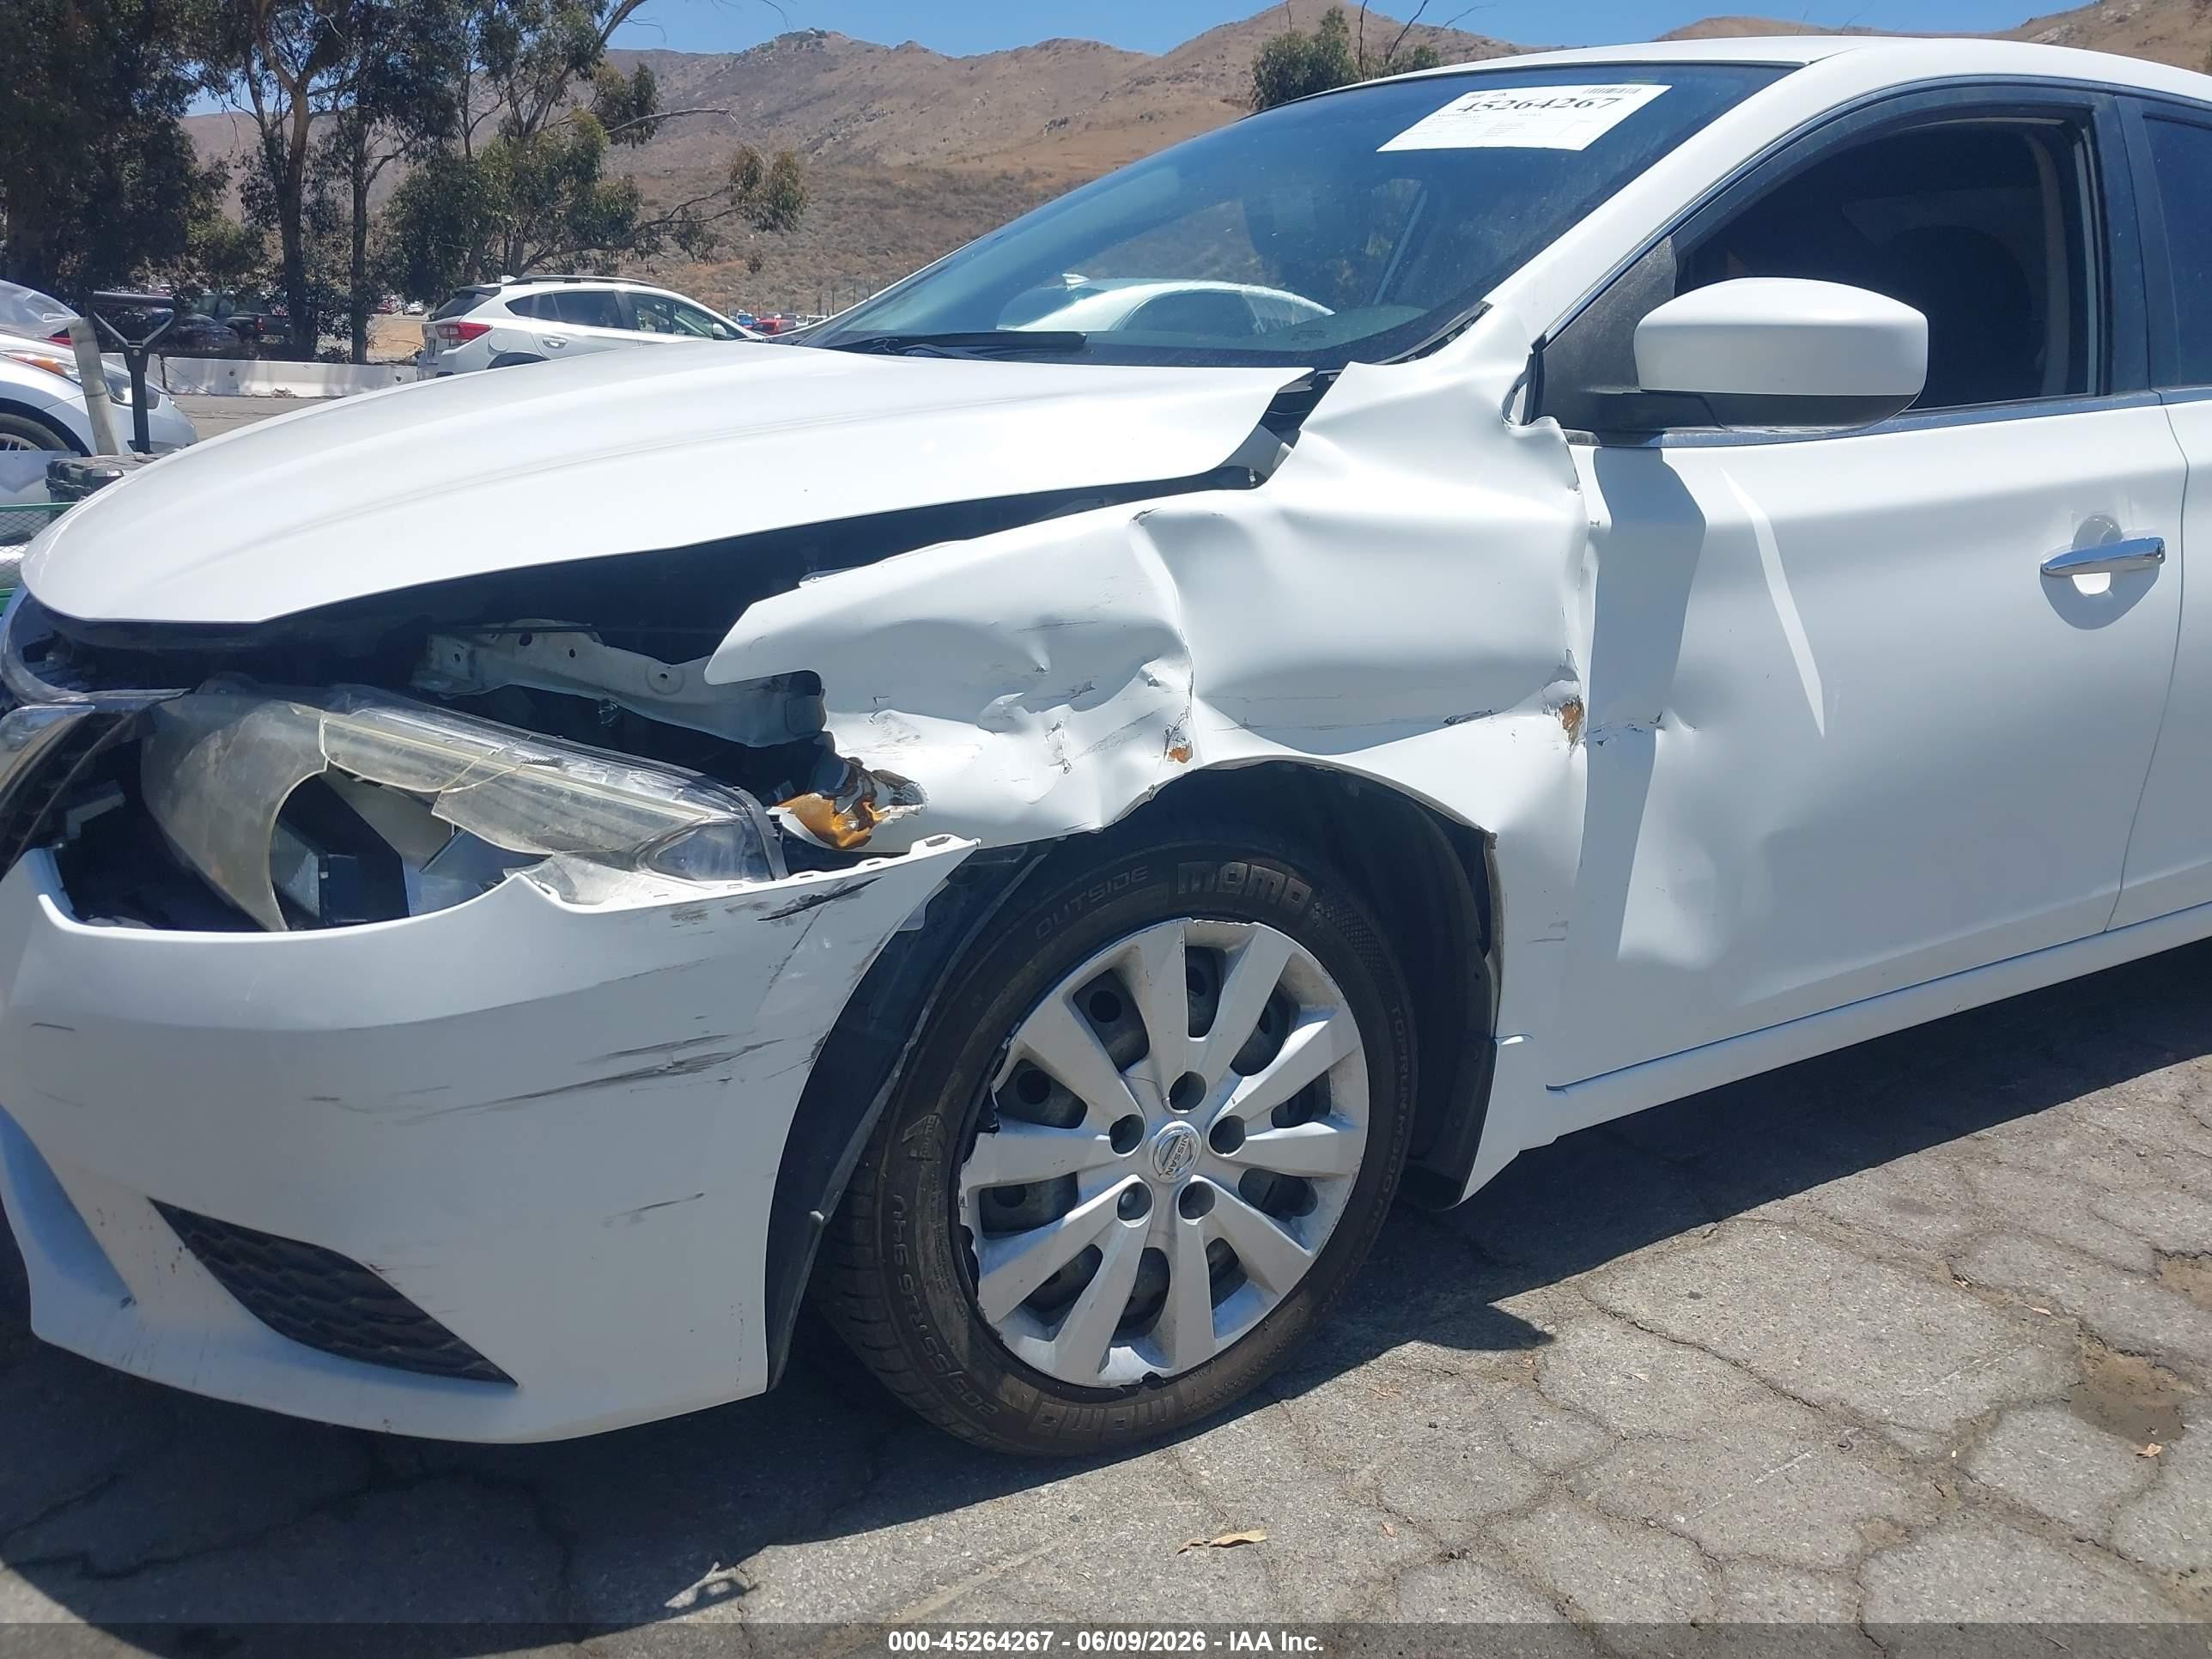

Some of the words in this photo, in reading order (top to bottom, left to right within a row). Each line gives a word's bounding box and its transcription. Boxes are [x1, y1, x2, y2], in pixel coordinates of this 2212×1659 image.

[1456, 97, 1623, 113] 45264267
[1036, 865, 1148, 941] OUTSIDE
[1165, 1132, 1190, 1176] NISSAN
